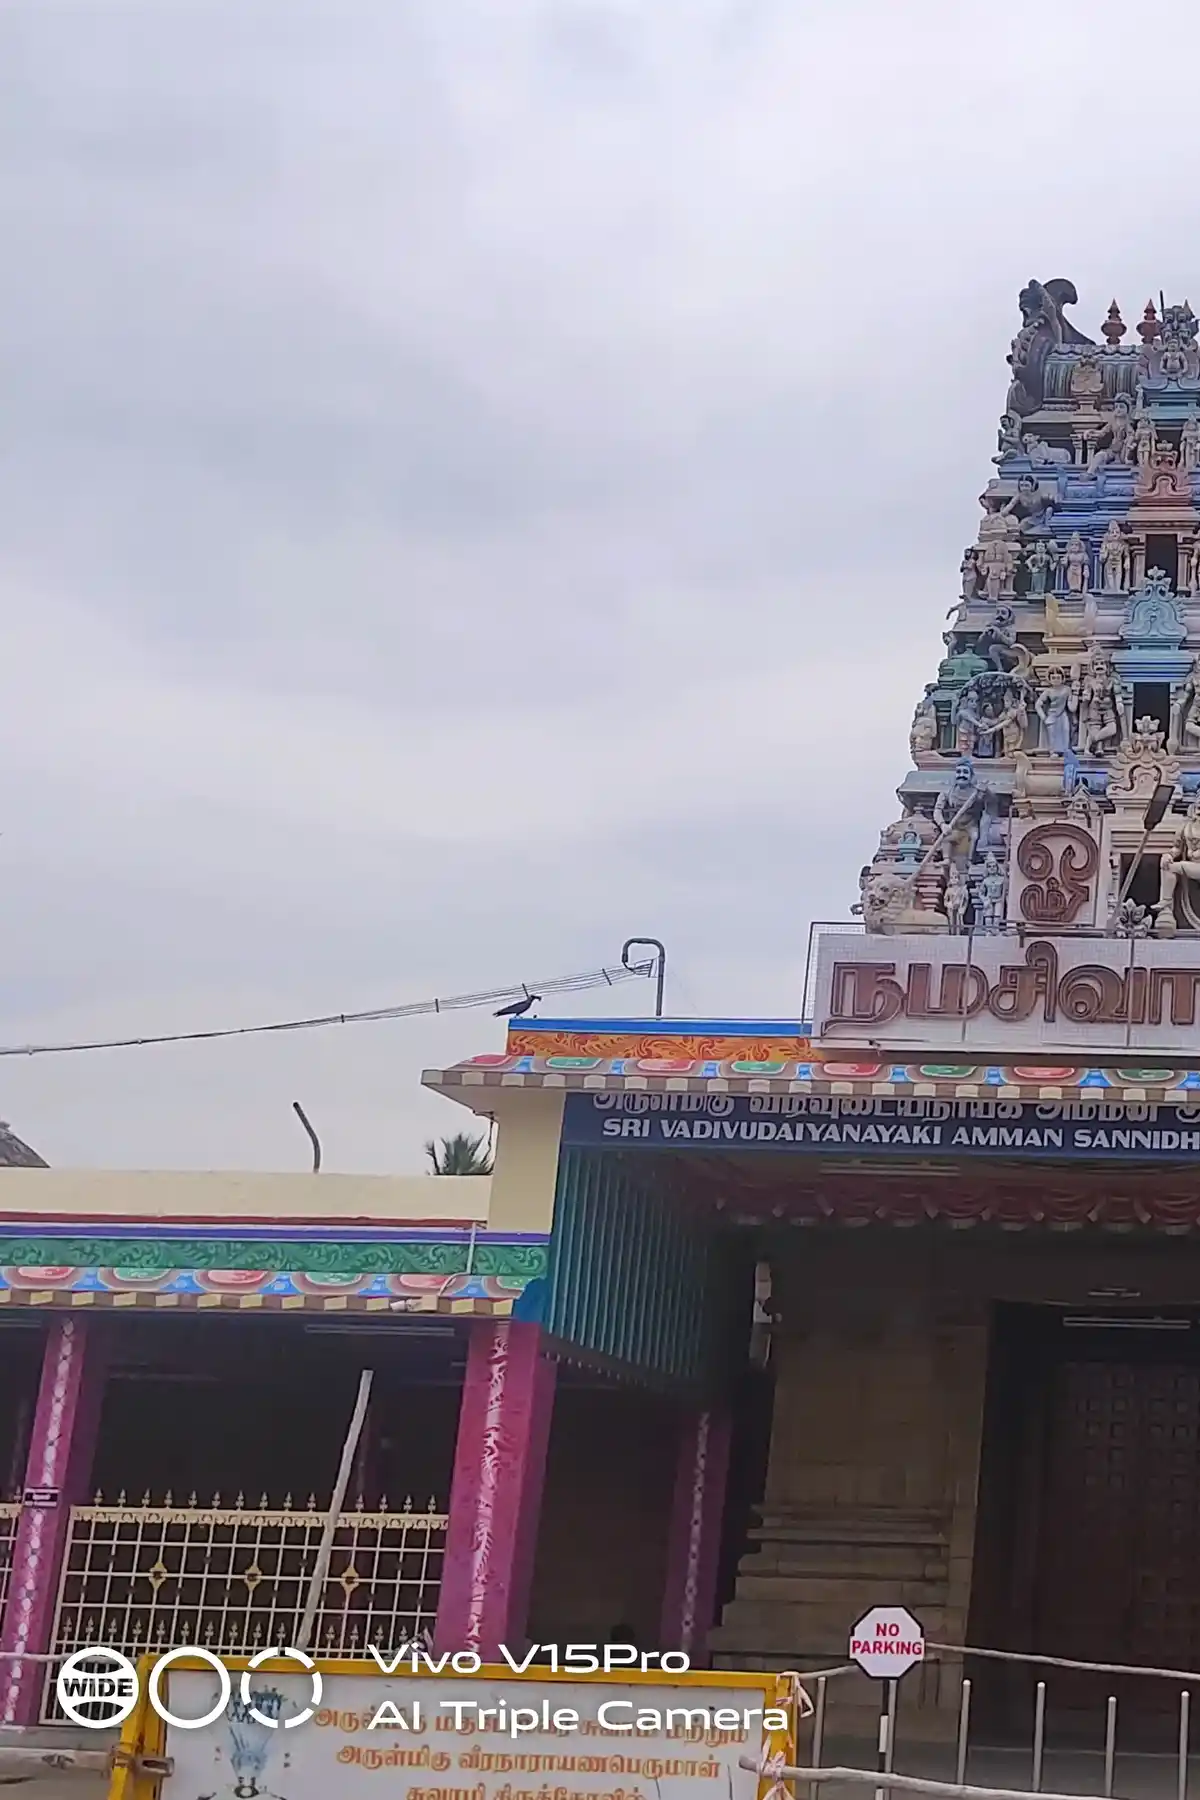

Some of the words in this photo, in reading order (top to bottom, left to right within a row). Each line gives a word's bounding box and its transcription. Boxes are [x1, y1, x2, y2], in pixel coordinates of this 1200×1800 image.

[602, 1118, 651, 1137] SRI
[660, 1119, 942, 1145] VADIVUDAIYANAYAKI
[951, 1126, 1063, 1148] AMMAN
[876, 1622, 900, 1637] NO
[851, 1640, 923, 1656] PARKING
[336, 1743, 451, 1772] அருள்மிகு
[458, 1744, 721, 1780] வீரநாராயணபெருமாள்
